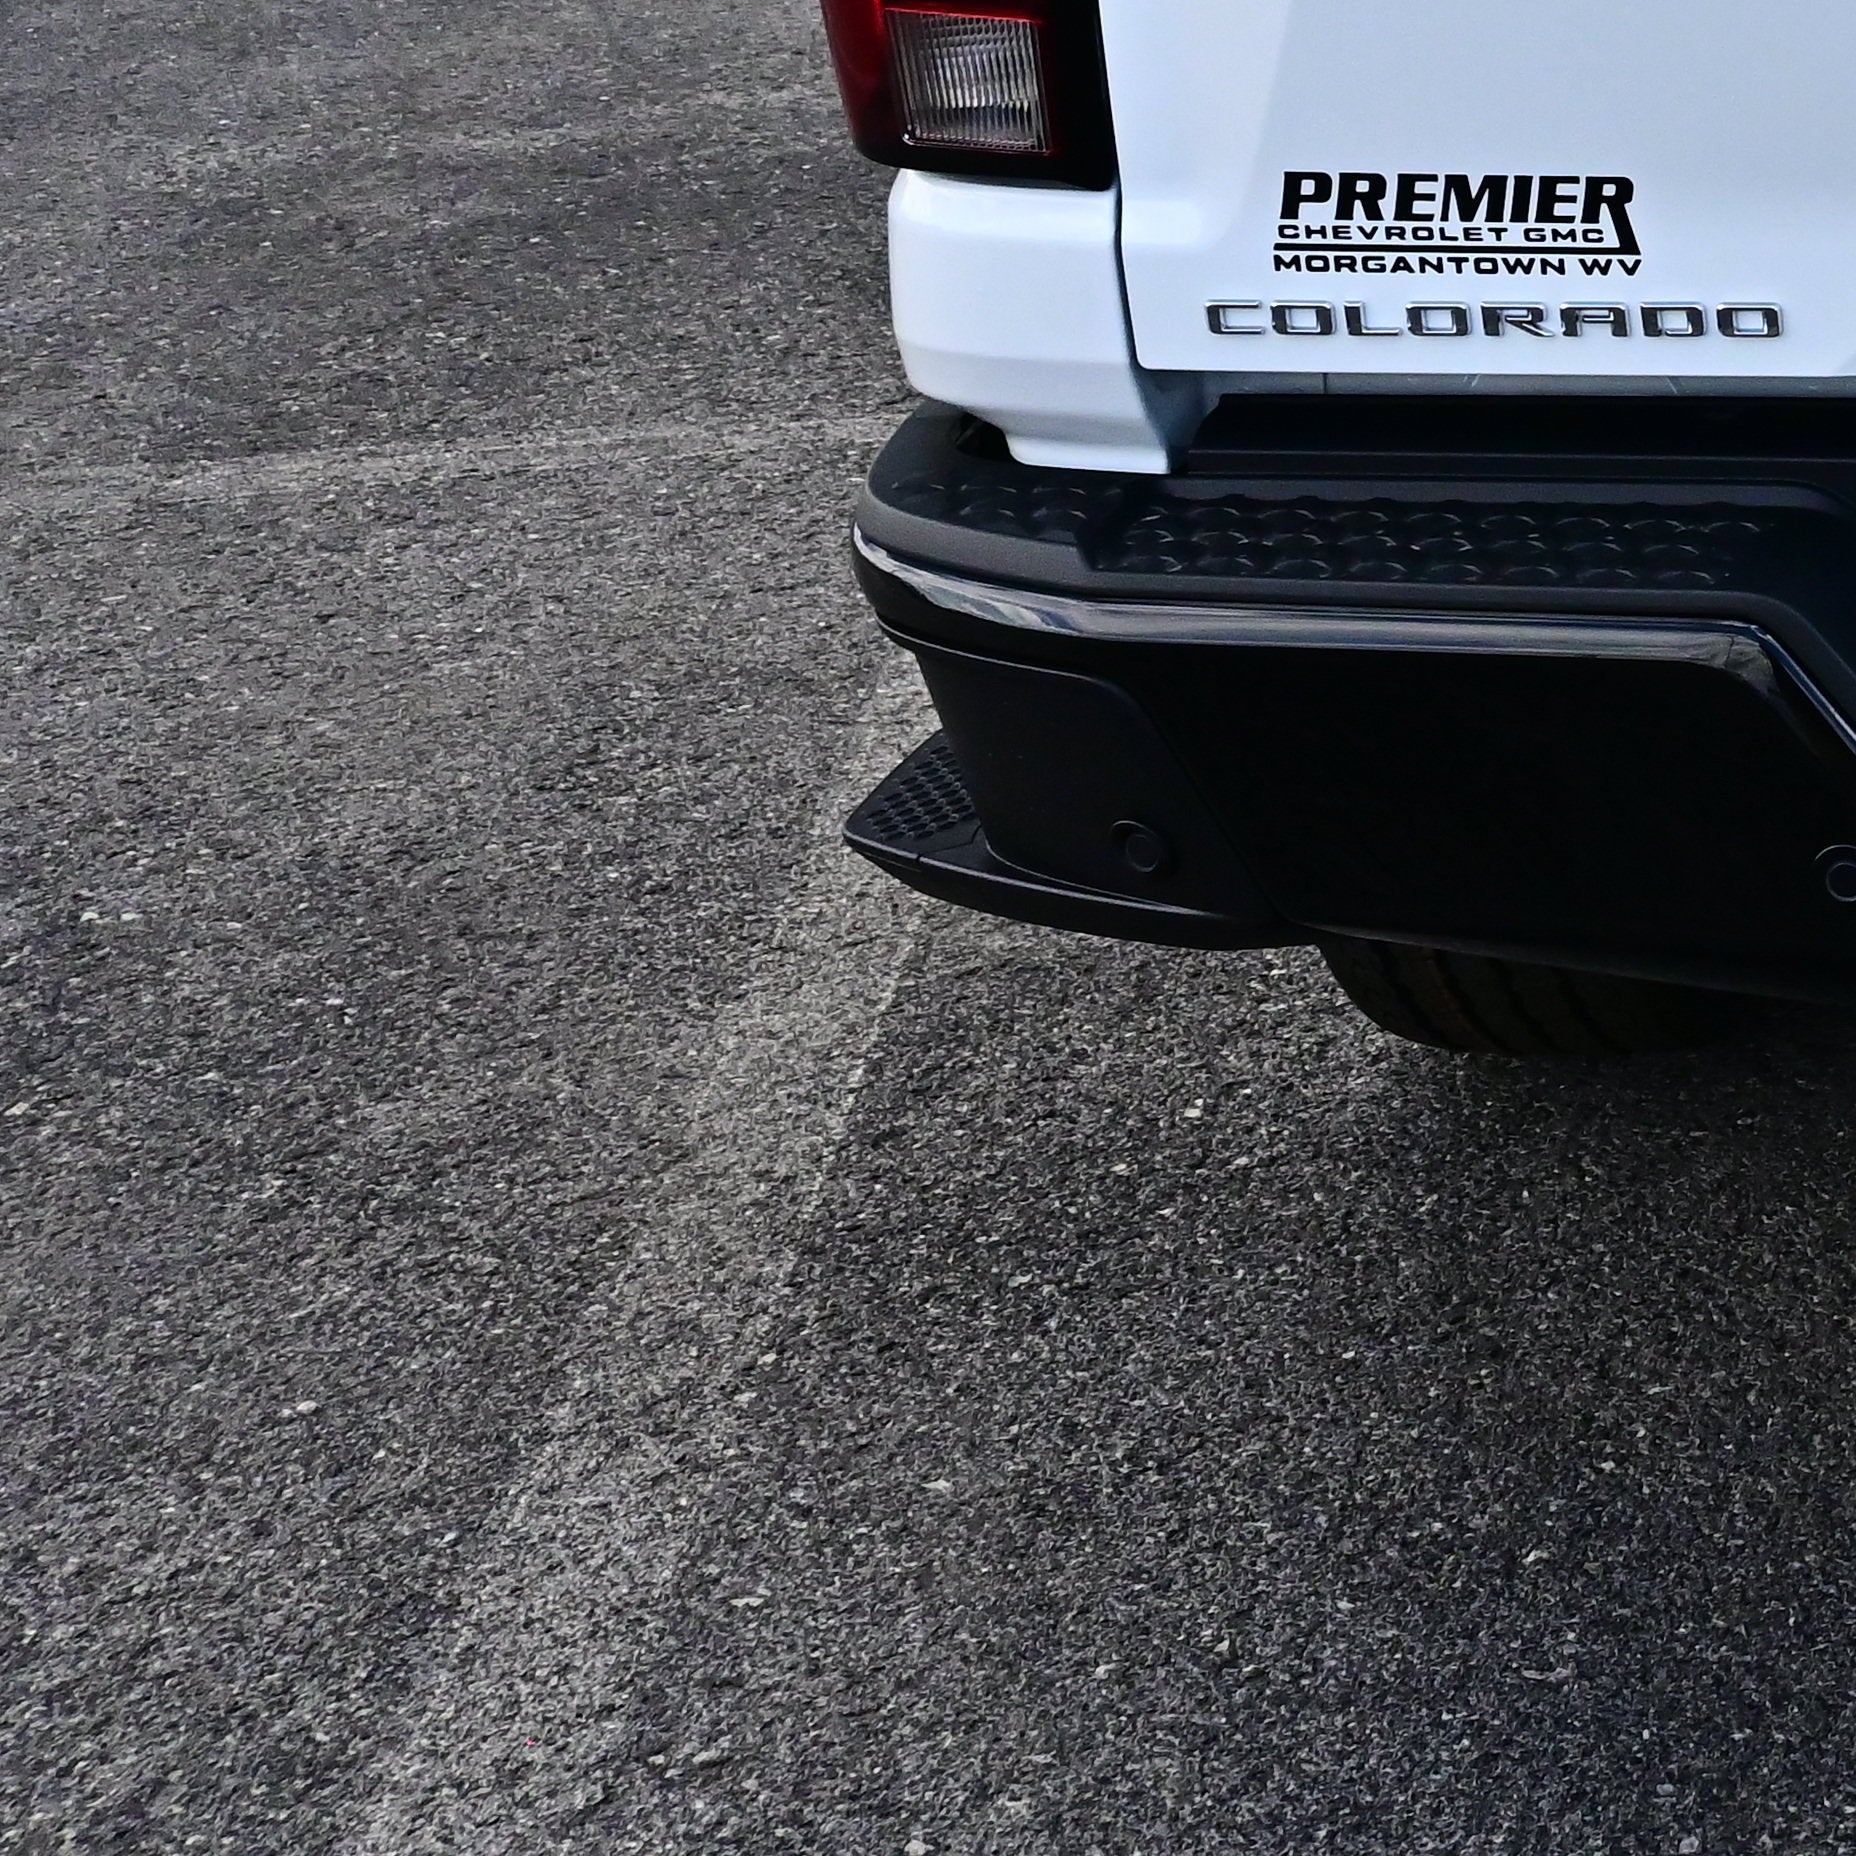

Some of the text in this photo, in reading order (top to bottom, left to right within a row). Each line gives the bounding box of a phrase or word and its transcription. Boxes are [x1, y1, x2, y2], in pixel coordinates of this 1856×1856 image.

[1280, 171, 1642, 255] PREMIER
[1276, 224, 1605, 243] CHEVROLET GMC
[1273, 254, 1643, 276] MORGANTOWN WV
[1204, 298, 1785, 338] COLORADO
